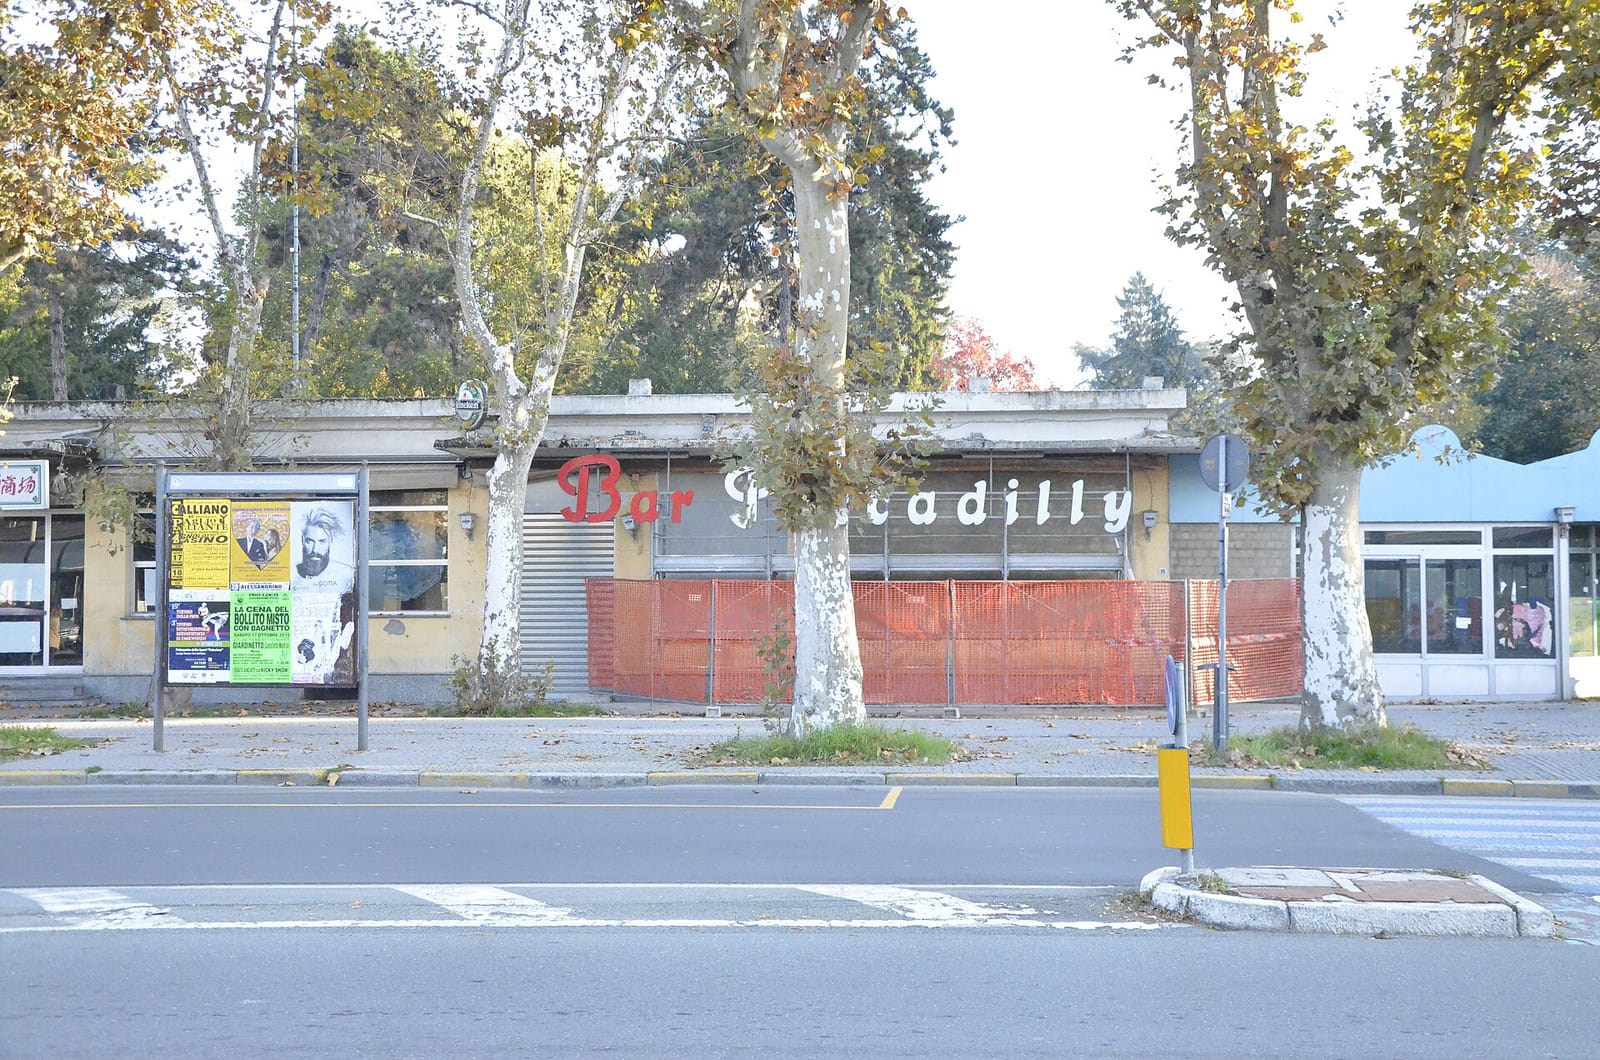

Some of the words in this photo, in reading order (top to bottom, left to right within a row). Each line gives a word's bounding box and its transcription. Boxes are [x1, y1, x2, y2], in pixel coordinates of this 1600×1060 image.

[0, 475, 36, 496] 商场
[557, 453, 694, 524] Bar
[724, 465, 1133, 534] Pcadilly
[171, 504, 228, 515] CALLIANO
[234, 613, 265, 625] BOLLITO
[266, 613, 290, 625] MISTO
